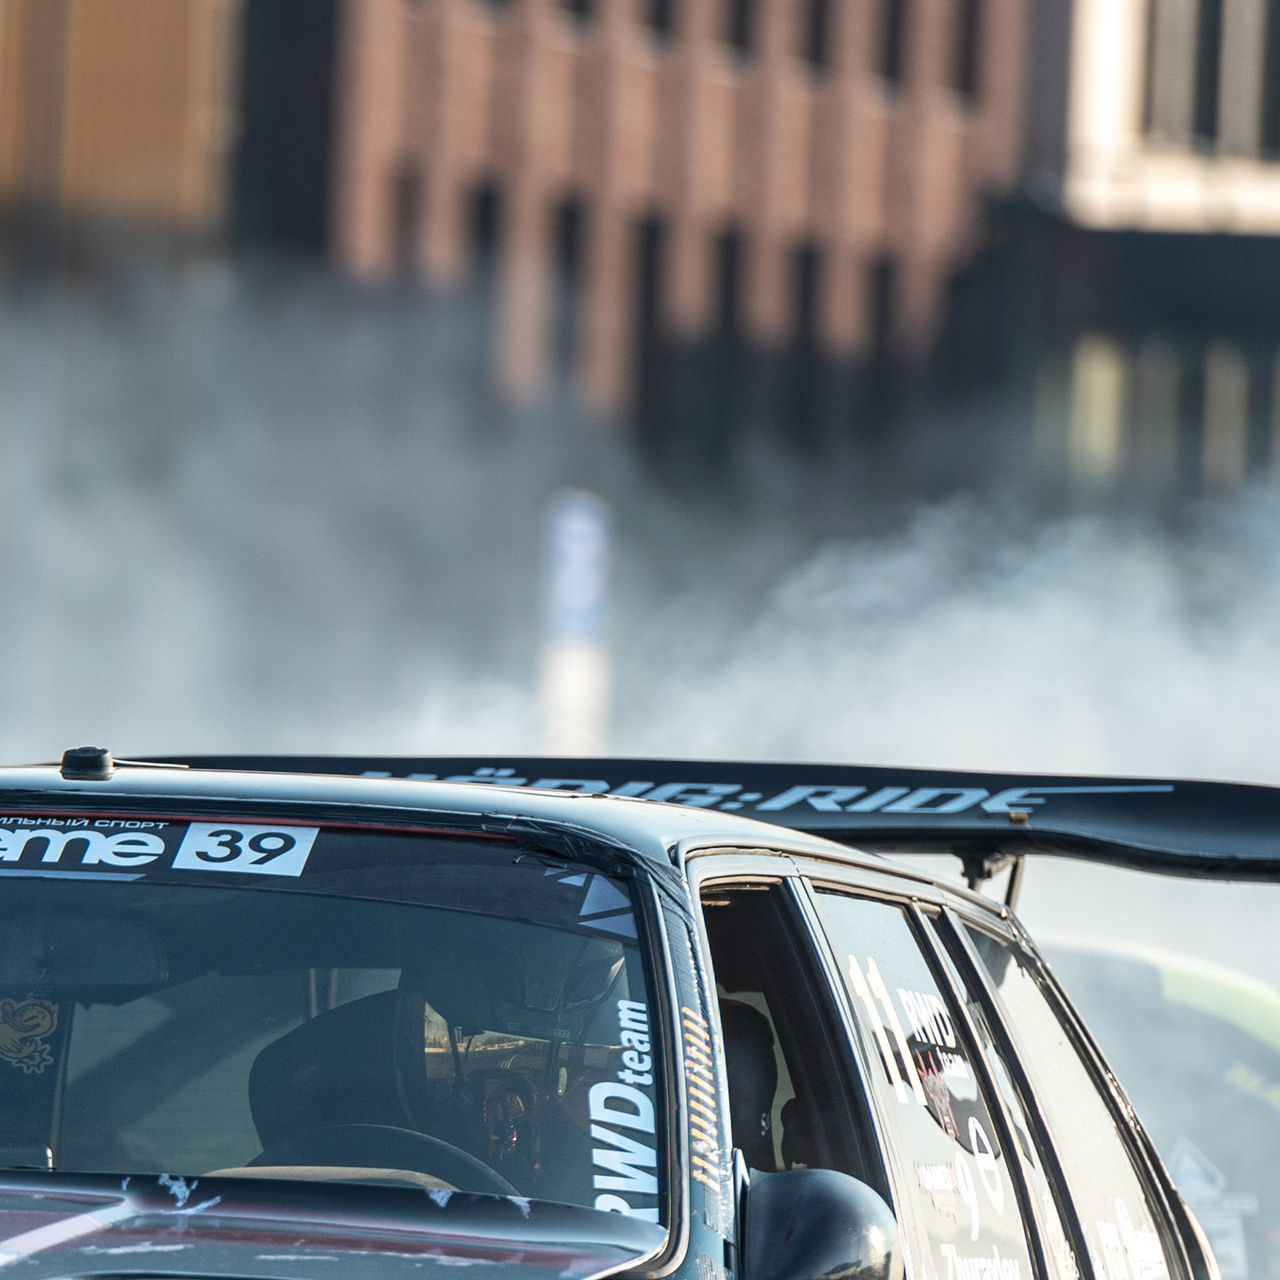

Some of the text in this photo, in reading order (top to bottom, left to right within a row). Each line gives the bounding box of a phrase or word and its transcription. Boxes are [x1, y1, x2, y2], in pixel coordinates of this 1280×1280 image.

[94, 819, 170, 830] СПОРТ
[194, 829, 298, 866] 39
[848, 954, 928, 1106] 11
[896, 988, 956, 1048] RWD
[617, 999, 654, 1086] team
[936, 1046, 970, 1080] team
